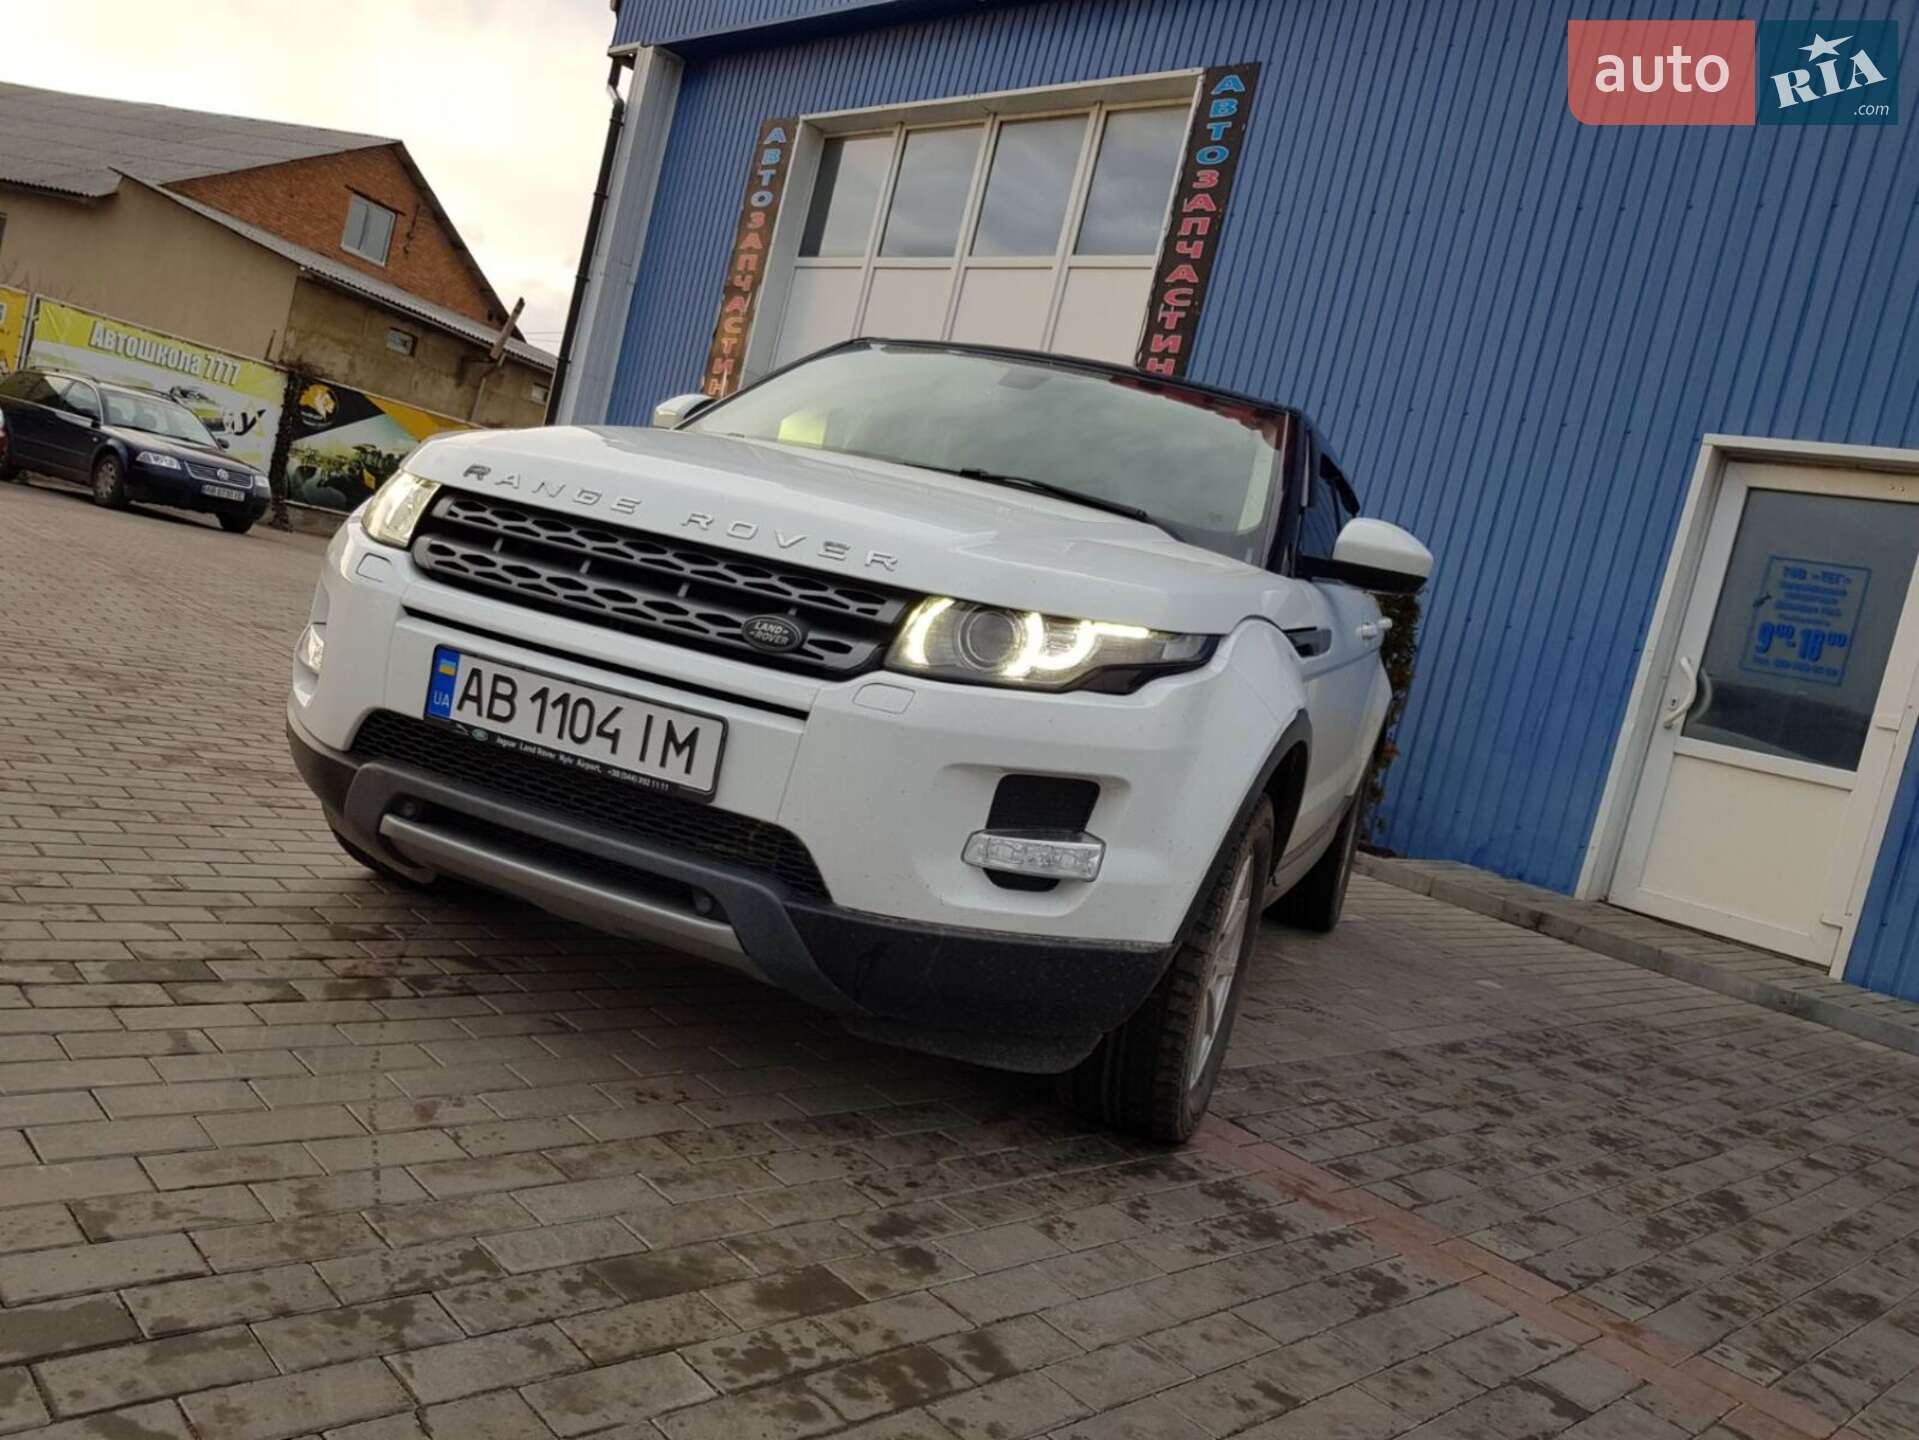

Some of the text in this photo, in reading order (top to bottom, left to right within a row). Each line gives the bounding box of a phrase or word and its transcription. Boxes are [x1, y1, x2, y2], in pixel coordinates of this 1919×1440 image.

[203, 354, 241, 386] 7777
[463, 463, 898, 571] RANGE ROVER
[433, 691, 450, 707] UA
[456, 668, 700, 774] AB 1104 IM
